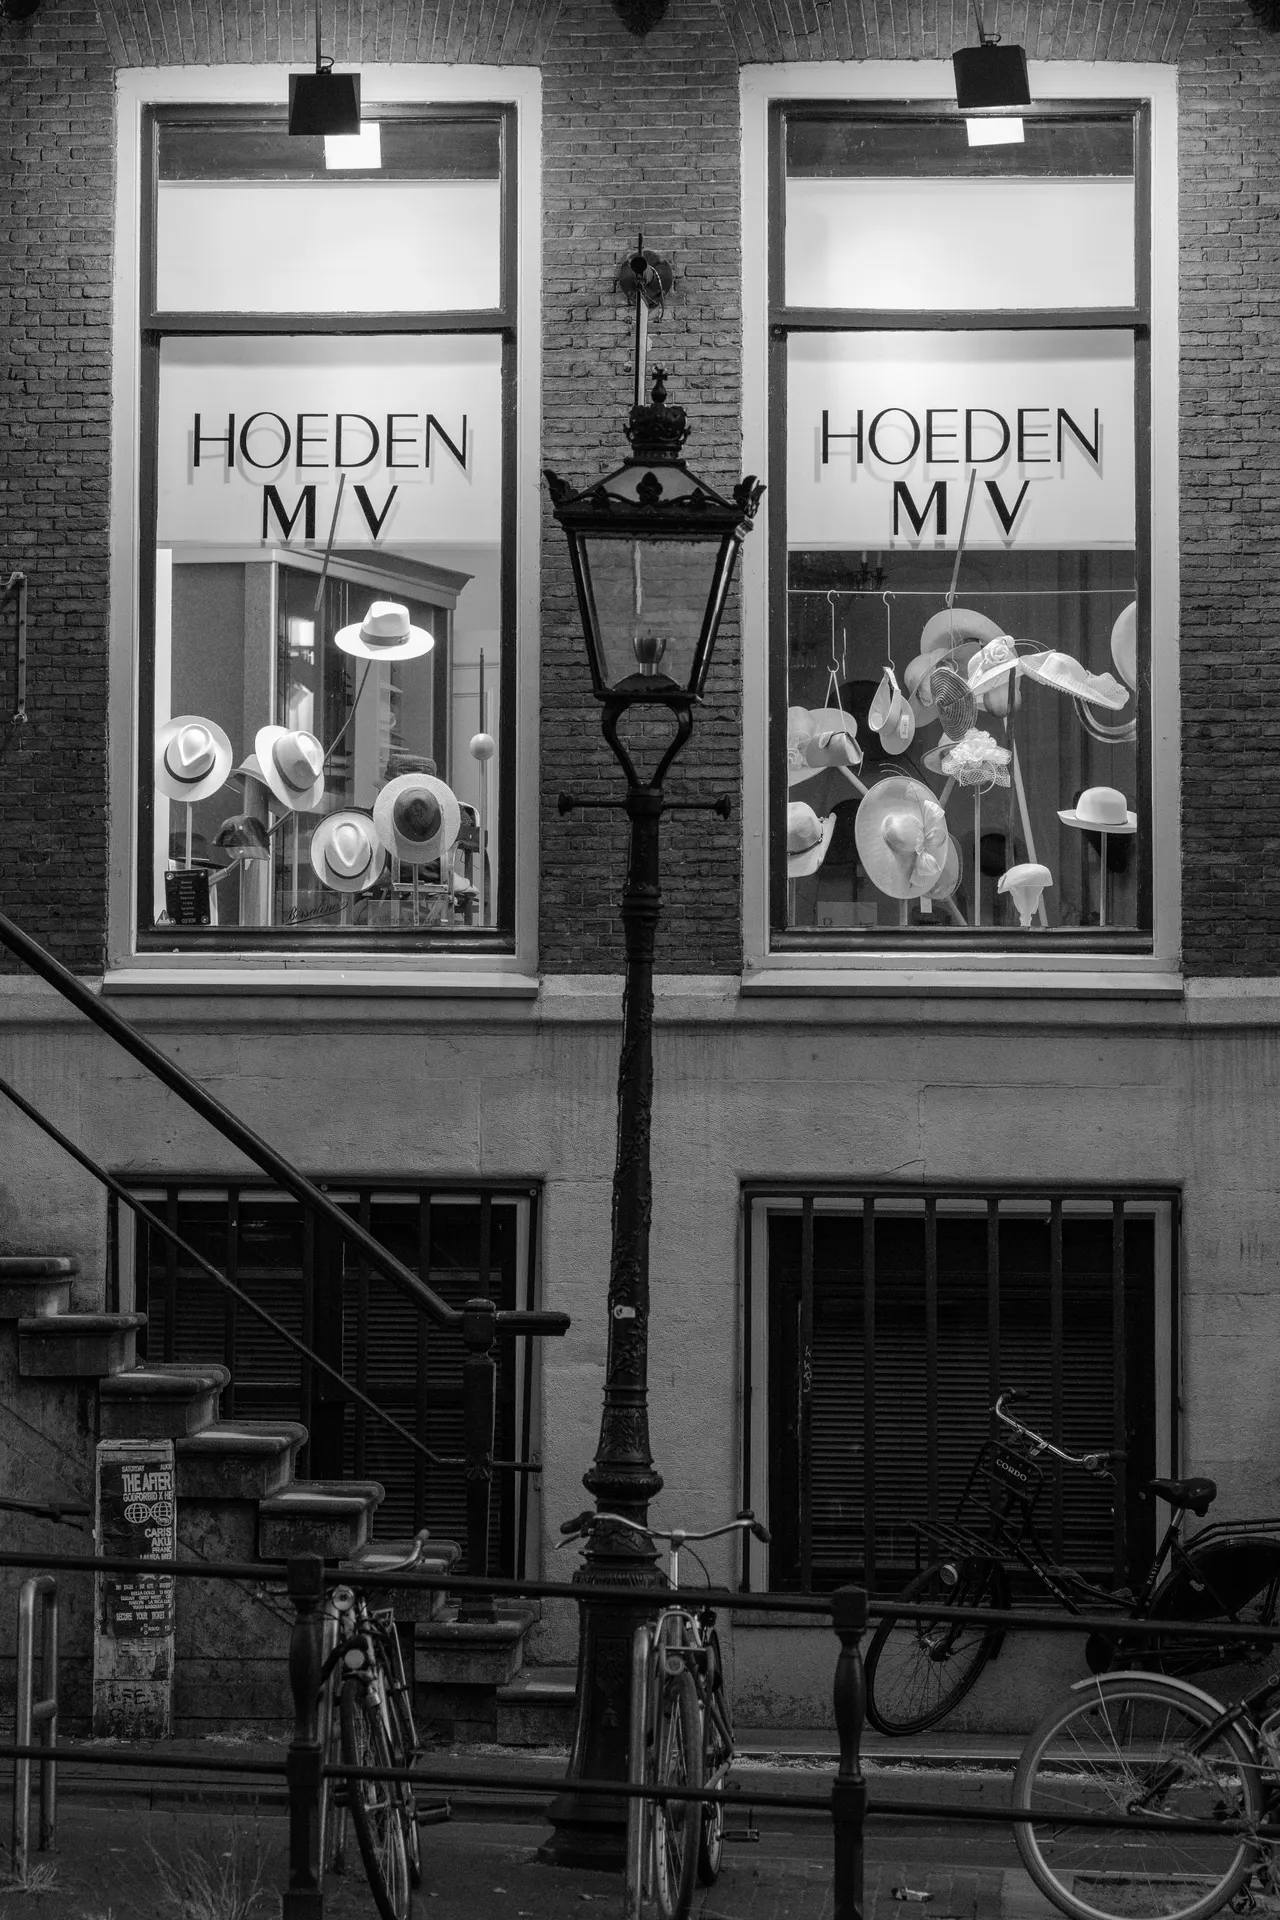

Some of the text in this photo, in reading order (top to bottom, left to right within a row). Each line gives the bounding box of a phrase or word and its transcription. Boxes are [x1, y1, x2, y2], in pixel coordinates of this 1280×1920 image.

[193, 412, 467, 469] HOEDEN
[822, 408, 1099, 465] HOEDEN
[996, 1459, 1027, 1481] CORDO
[121, 1472, 171, 1492] THE AFTER
[158, 1491, 163, 1500] X
[144, 1527, 172, 1538] CARIS
[1147, 1561, 1161, 1585] BASIC
[116, 1612, 132, 1621] SECURE
[135, 1611, 148, 1620] YOUR
